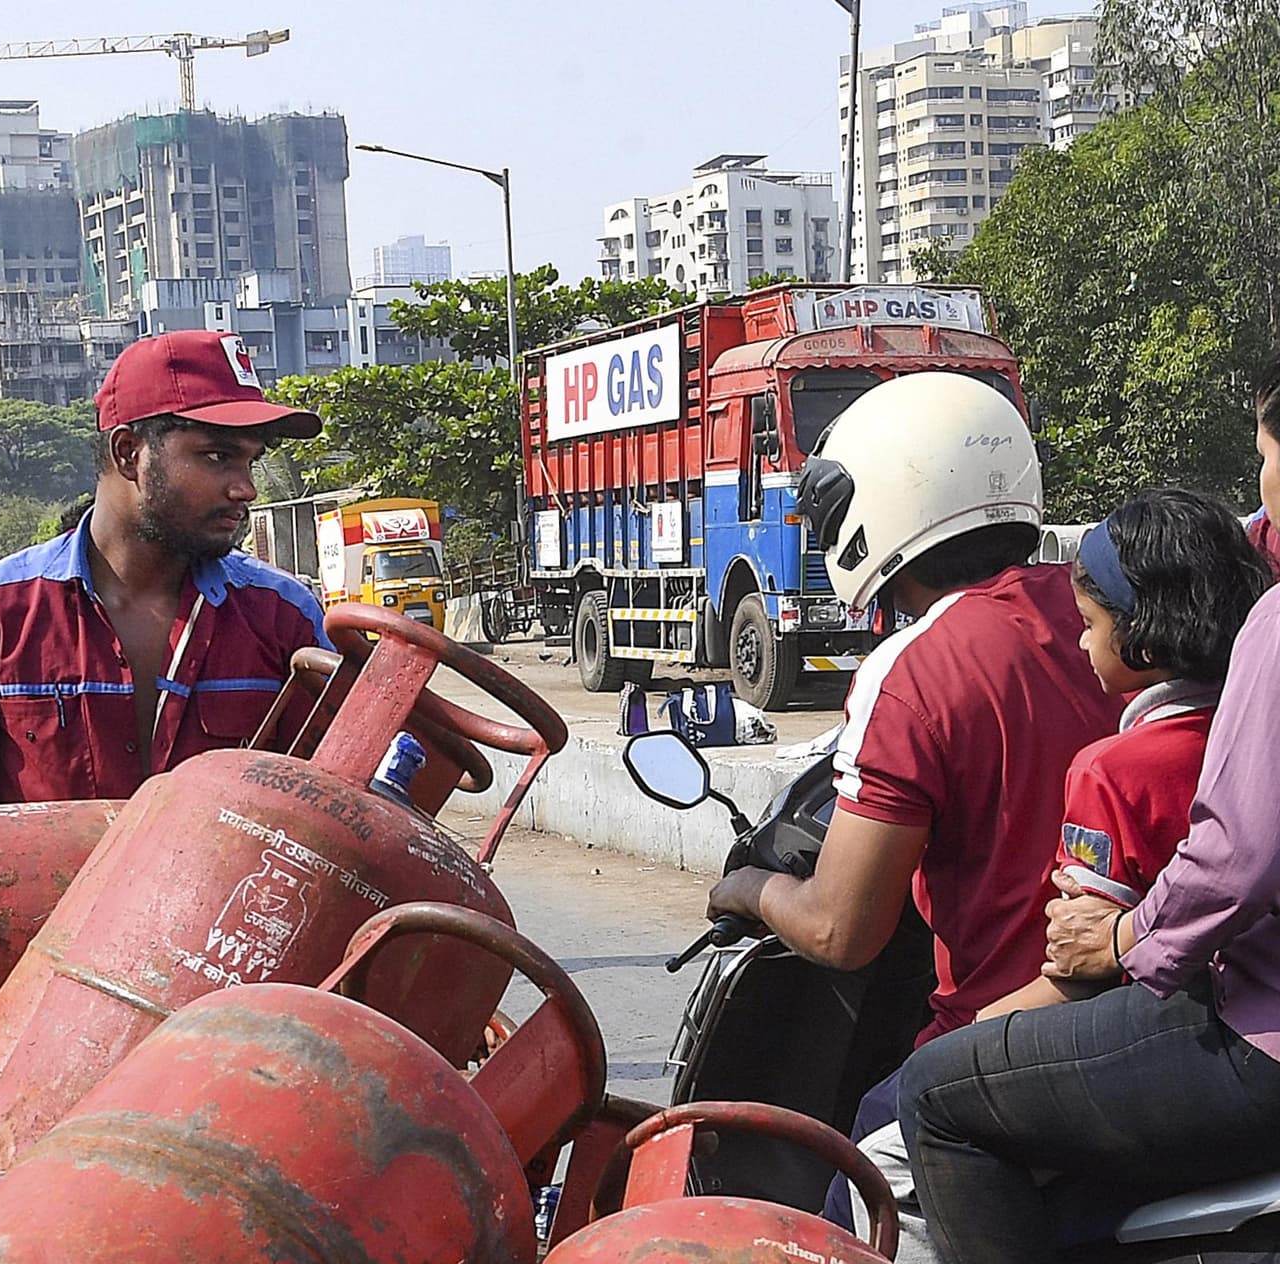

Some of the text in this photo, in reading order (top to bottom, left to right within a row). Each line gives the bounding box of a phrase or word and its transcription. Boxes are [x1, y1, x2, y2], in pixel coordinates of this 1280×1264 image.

[844, 299, 937, 320] HP GAS
[563, 343, 664, 425] HP GAS
[339, 867, 391, 909] योजना
